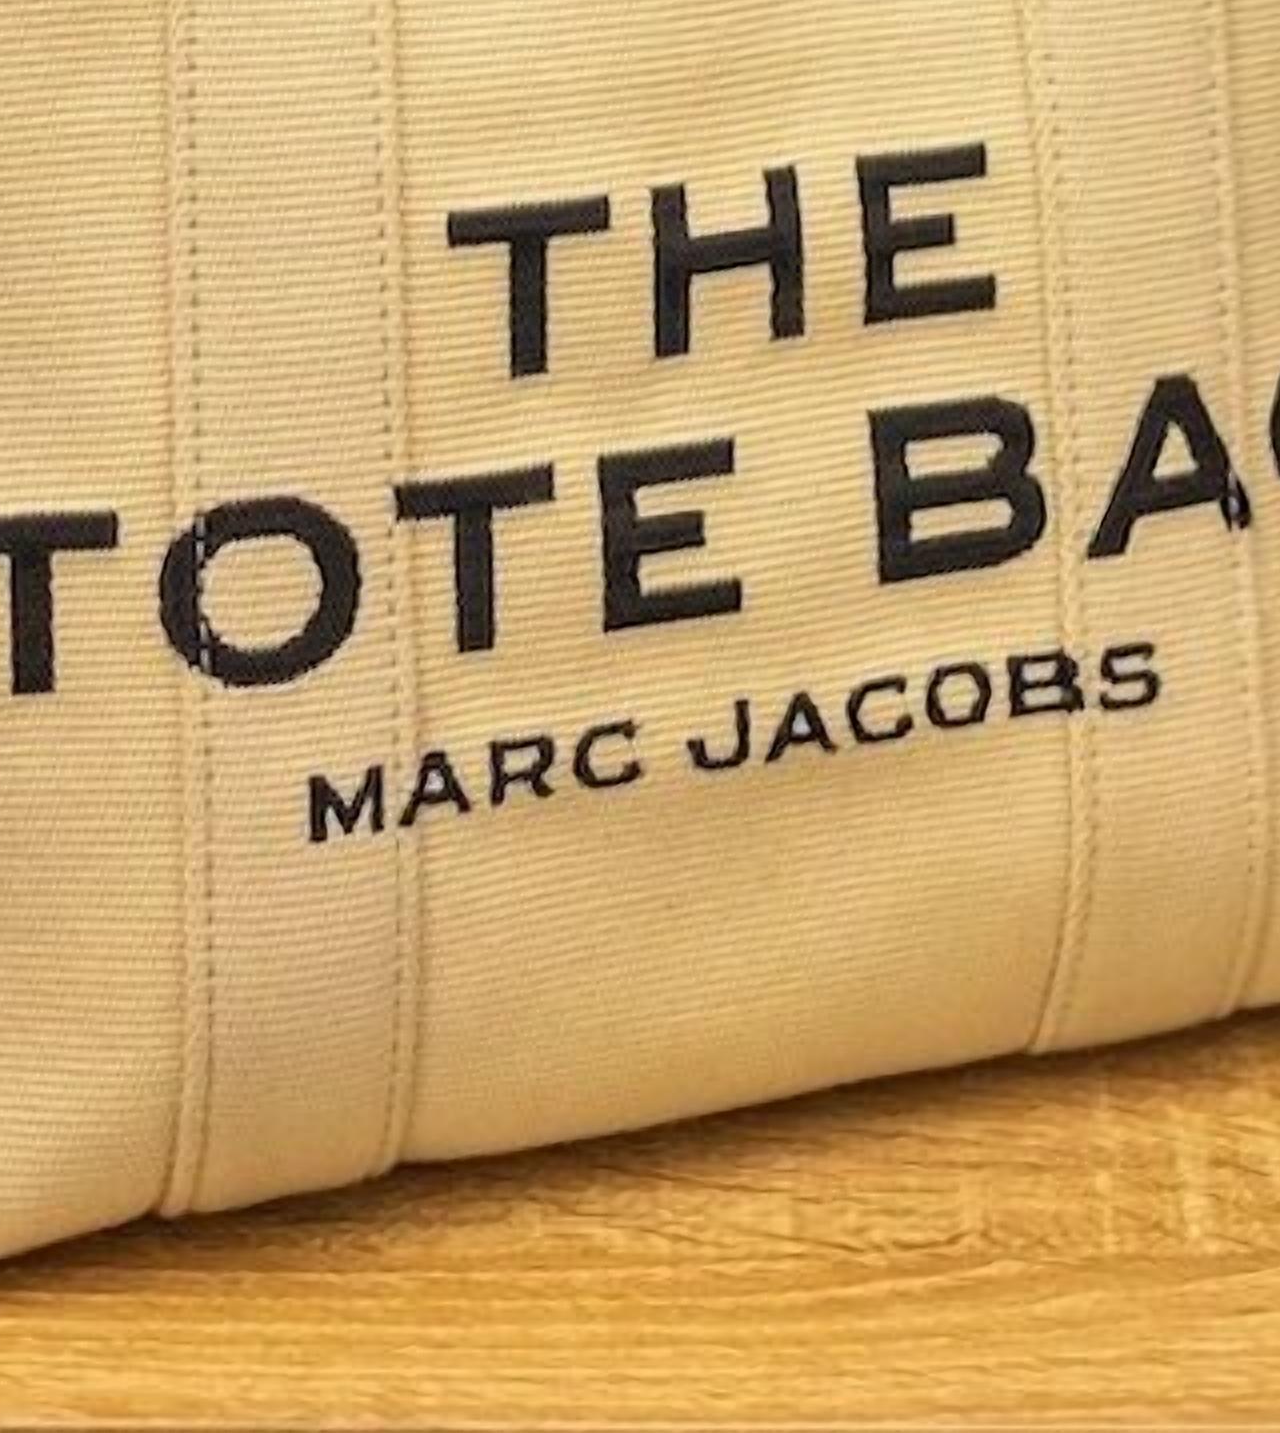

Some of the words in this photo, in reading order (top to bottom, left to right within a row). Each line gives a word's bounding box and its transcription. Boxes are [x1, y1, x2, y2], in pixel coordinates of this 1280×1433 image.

[445, 142, 998, 381] THE
[307, 718, 645, 845] MARC
[685, 641, 1162, 773] JACOBS
